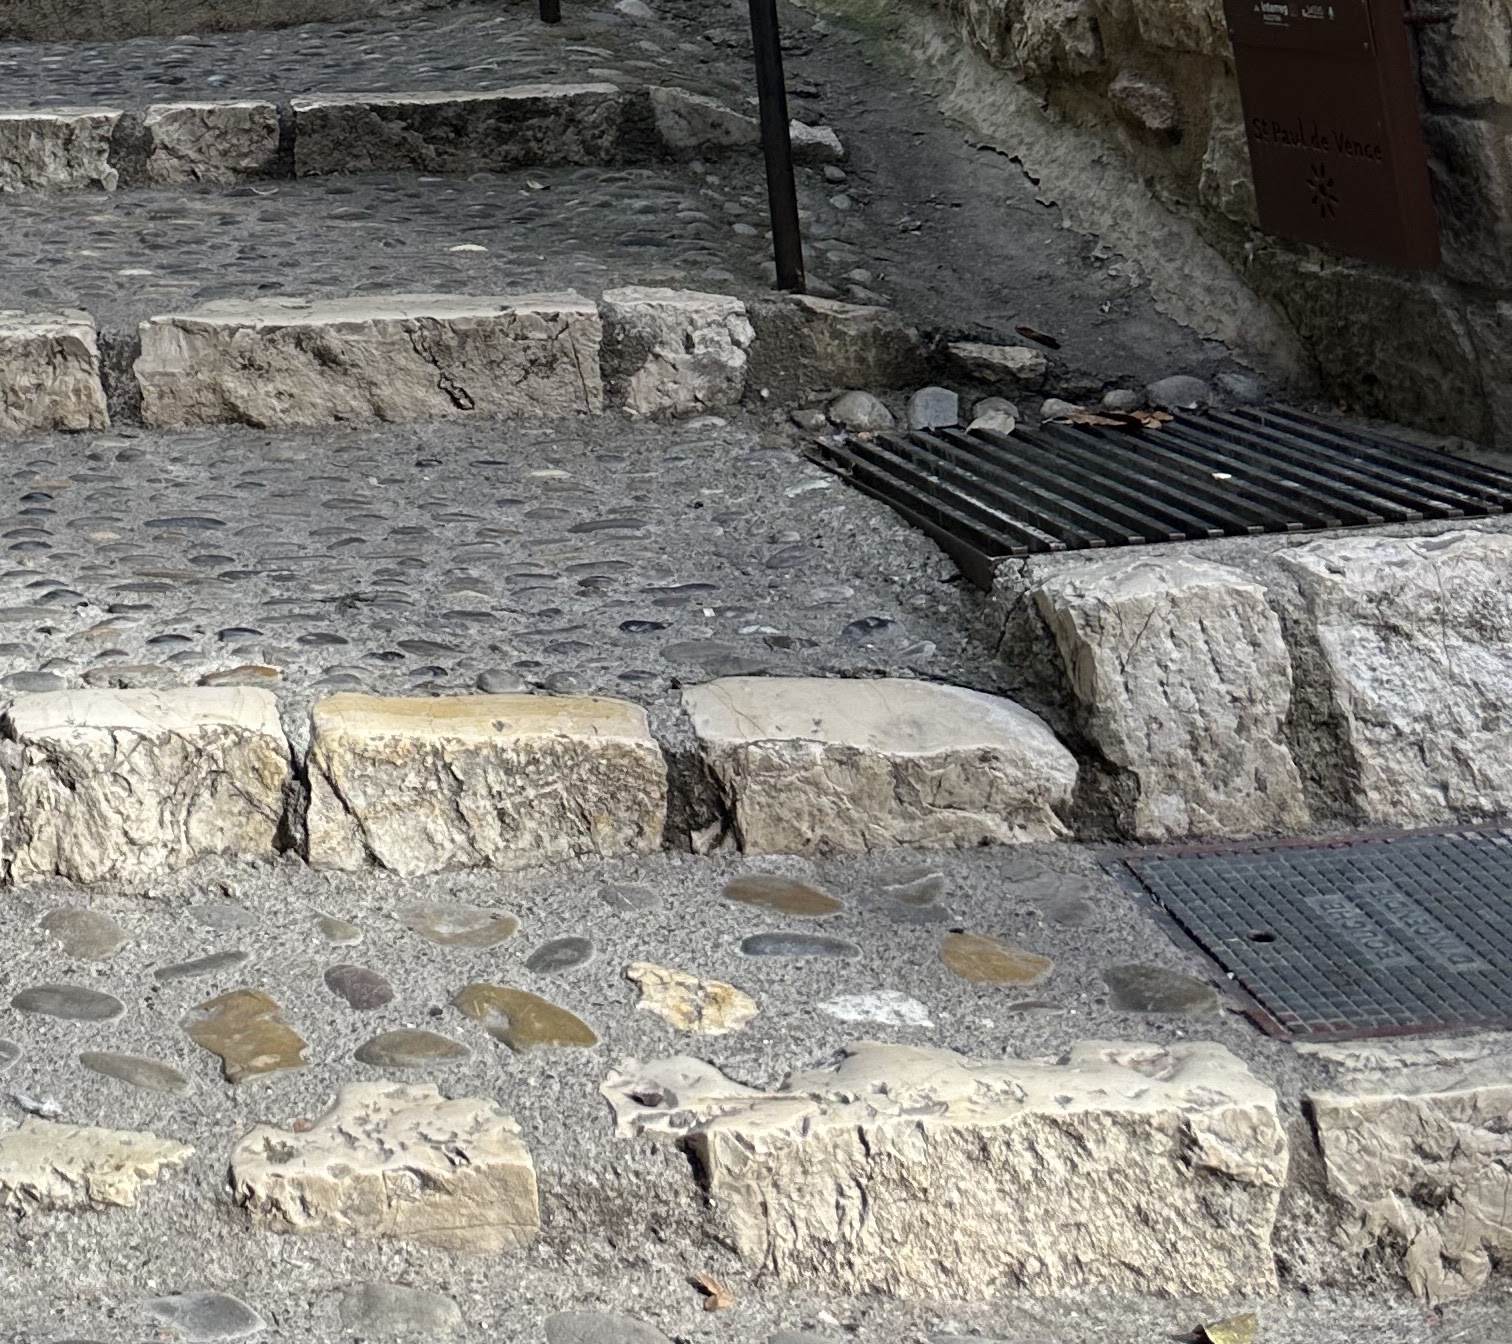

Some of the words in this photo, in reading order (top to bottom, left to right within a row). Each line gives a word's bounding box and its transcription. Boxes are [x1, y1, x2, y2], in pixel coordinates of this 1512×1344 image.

[1271, 117, 1306, 145] Paul
[1311, 120, 1329, 150] de
[1331, 130, 1383, 160] Vence
[1320, 902, 1403, 960] BOUCHE
